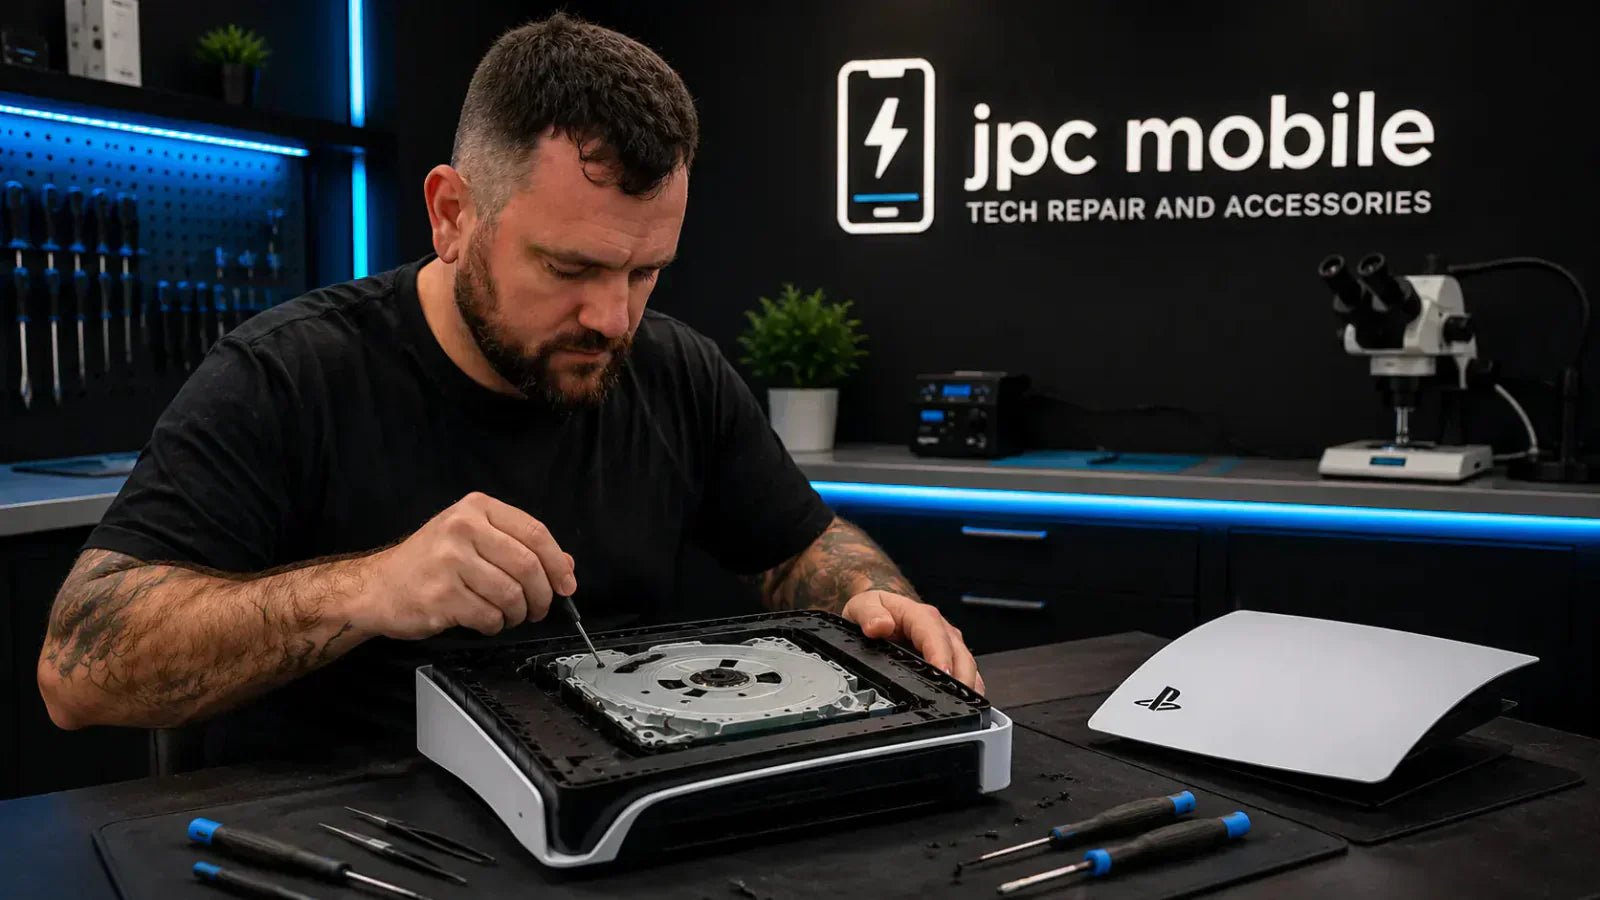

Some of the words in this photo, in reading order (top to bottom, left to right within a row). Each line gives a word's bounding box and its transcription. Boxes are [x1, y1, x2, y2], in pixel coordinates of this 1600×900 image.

[963, 102, 1097, 192] jpc
[1126, 90, 1435, 173] mobile
[967, 200, 1038, 224] TECH
[1047, 197, 1145, 221] REPAIR
[1154, 196, 1215, 219] AND
[1224, 190, 1431, 218] ACCESSORIES
